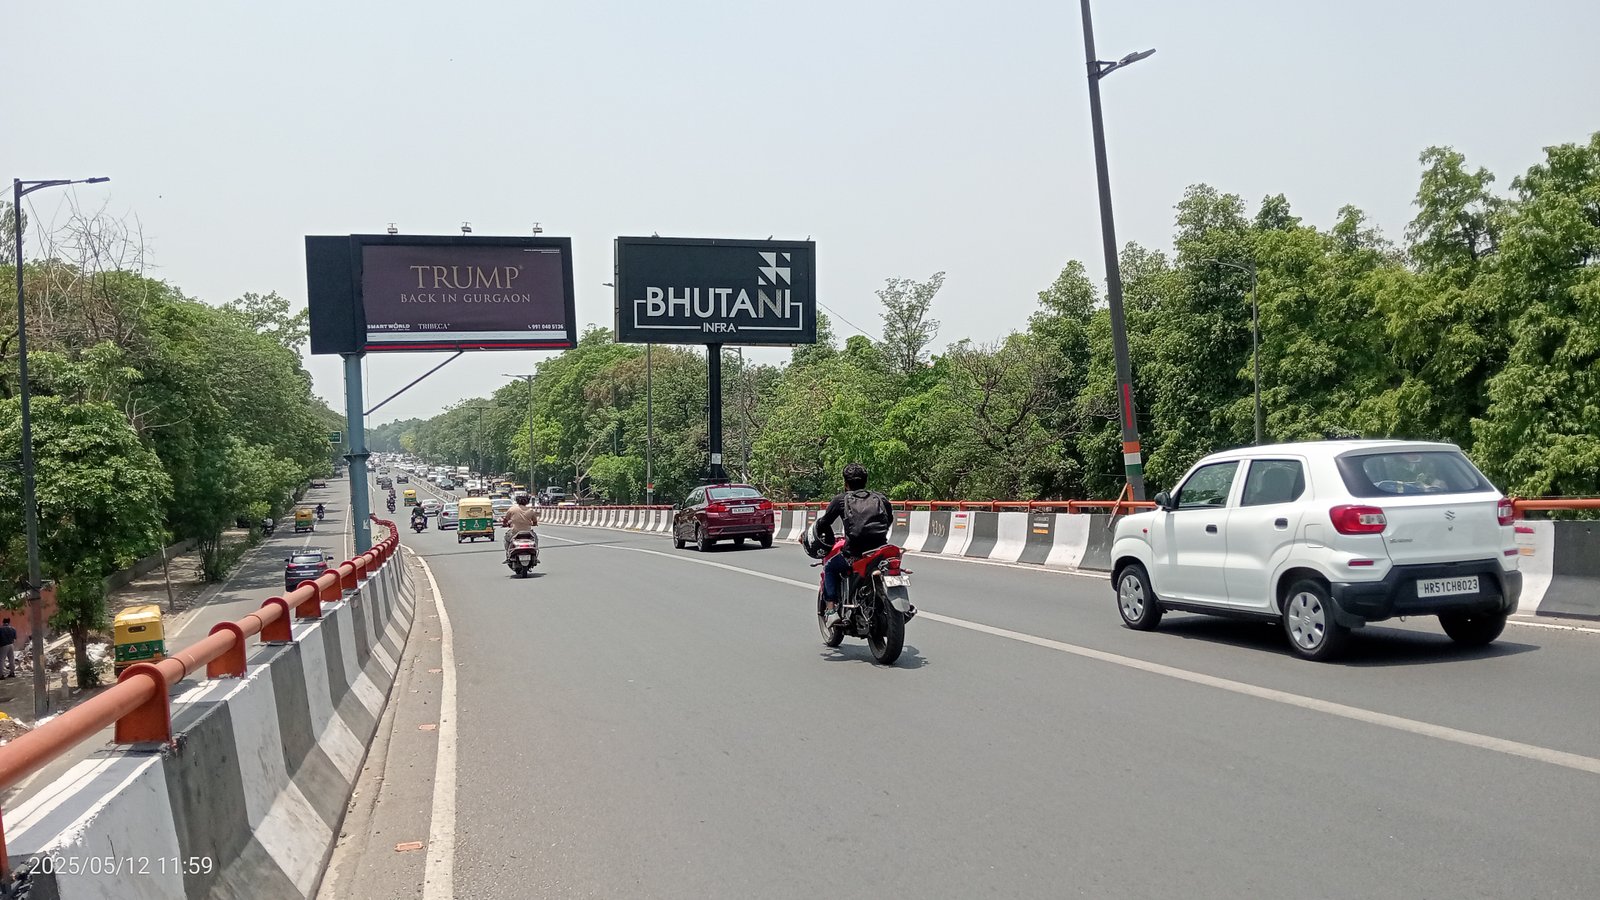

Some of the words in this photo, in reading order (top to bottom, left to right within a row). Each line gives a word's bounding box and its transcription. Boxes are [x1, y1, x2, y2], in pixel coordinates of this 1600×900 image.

[409, 265, 520, 289] TRUMP
[400, 293, 437, 303] BACK
[442, 293, 457, 303] IN
[463, 293, 531, 303] GURGAON
[646, 286, 791, 319] BHUTANI
[702, 322, 737, 333] INFRA
[1423, 579, 1478, 594] HR51CH8023
